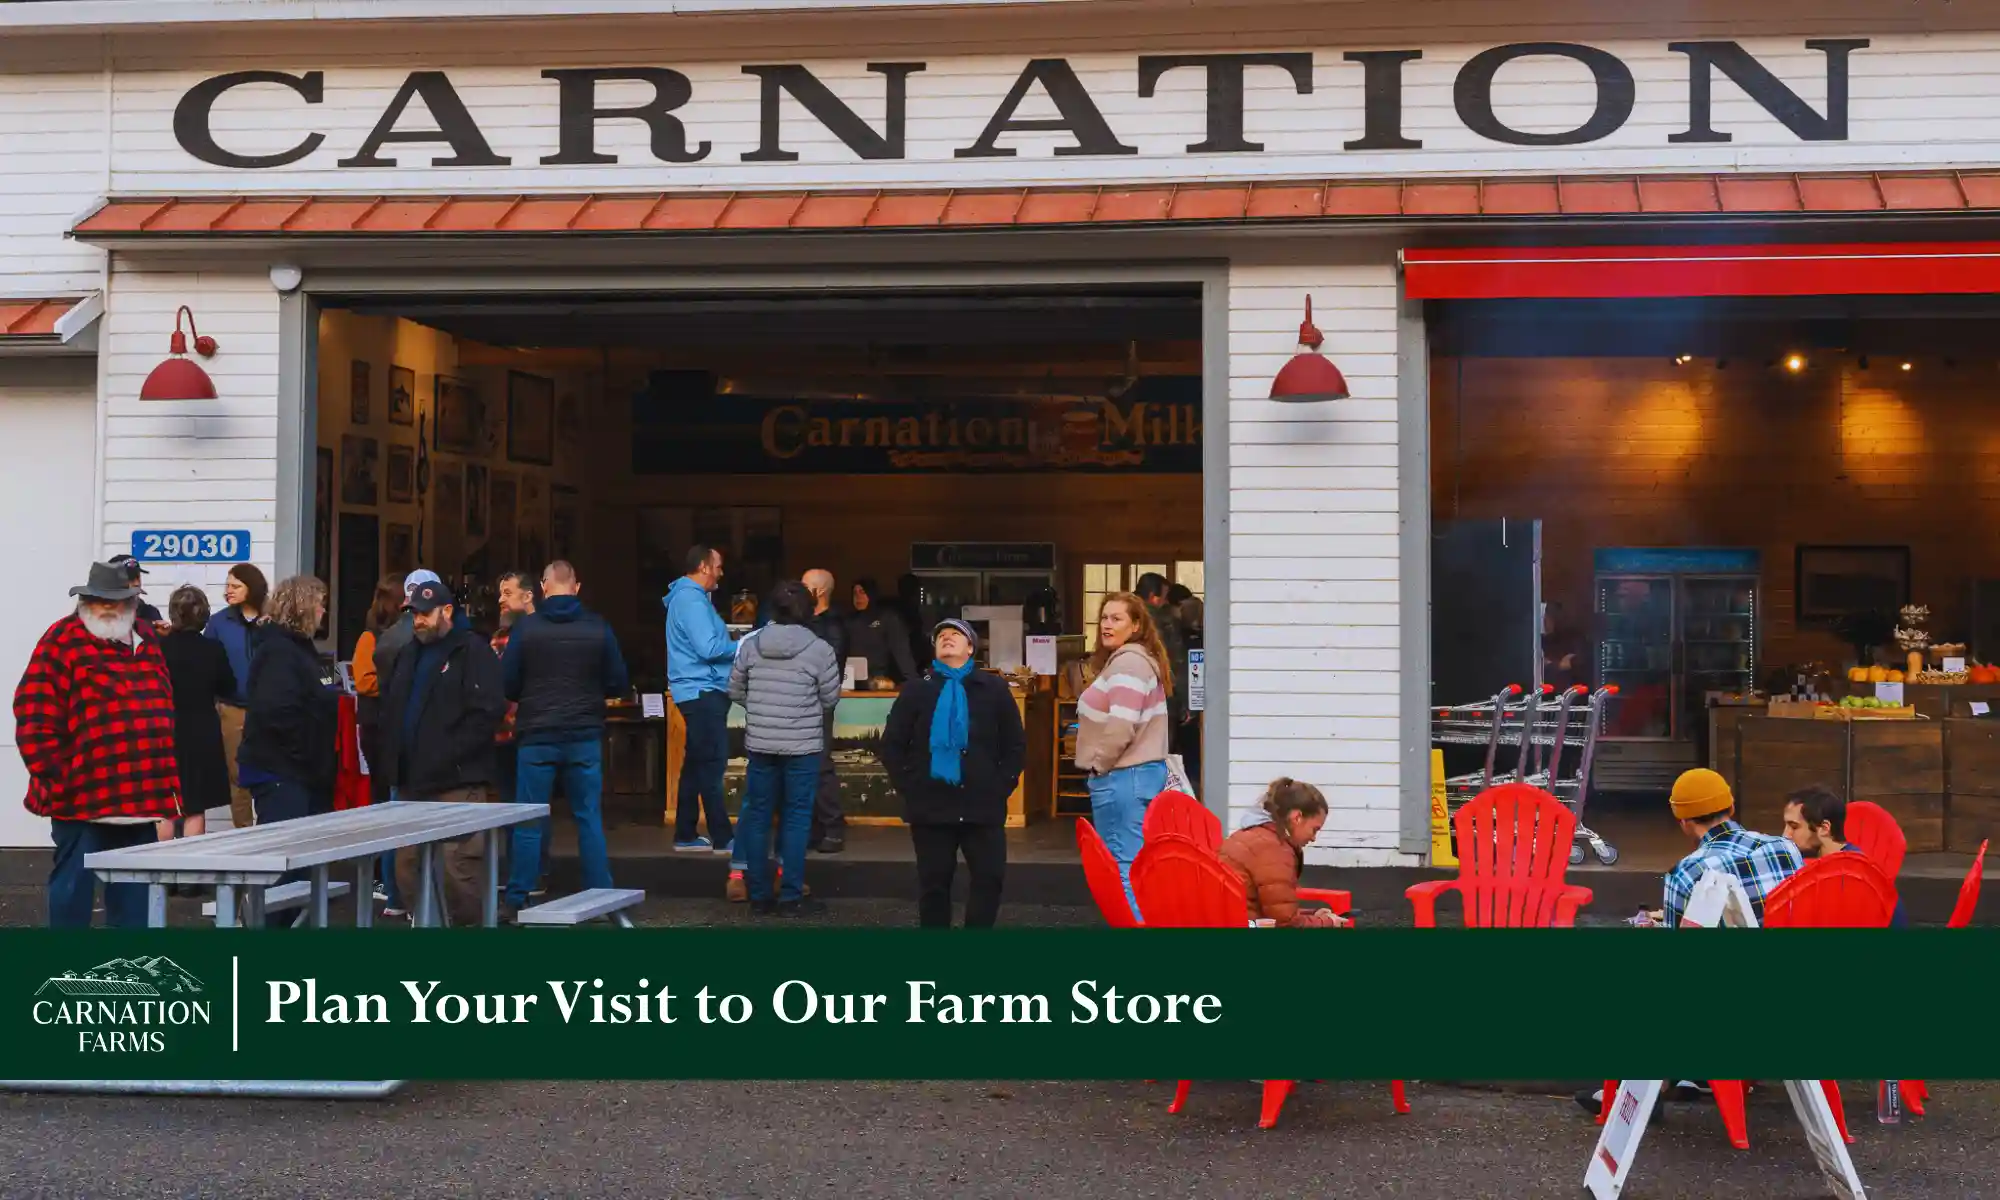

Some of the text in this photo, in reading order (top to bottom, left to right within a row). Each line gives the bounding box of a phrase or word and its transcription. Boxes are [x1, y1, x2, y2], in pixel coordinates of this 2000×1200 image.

[172, 38, 1870, 170] CARNATION
[760, 400, 1203, 460] Carnation Milk
[143, 533, 238, 558] 29030
